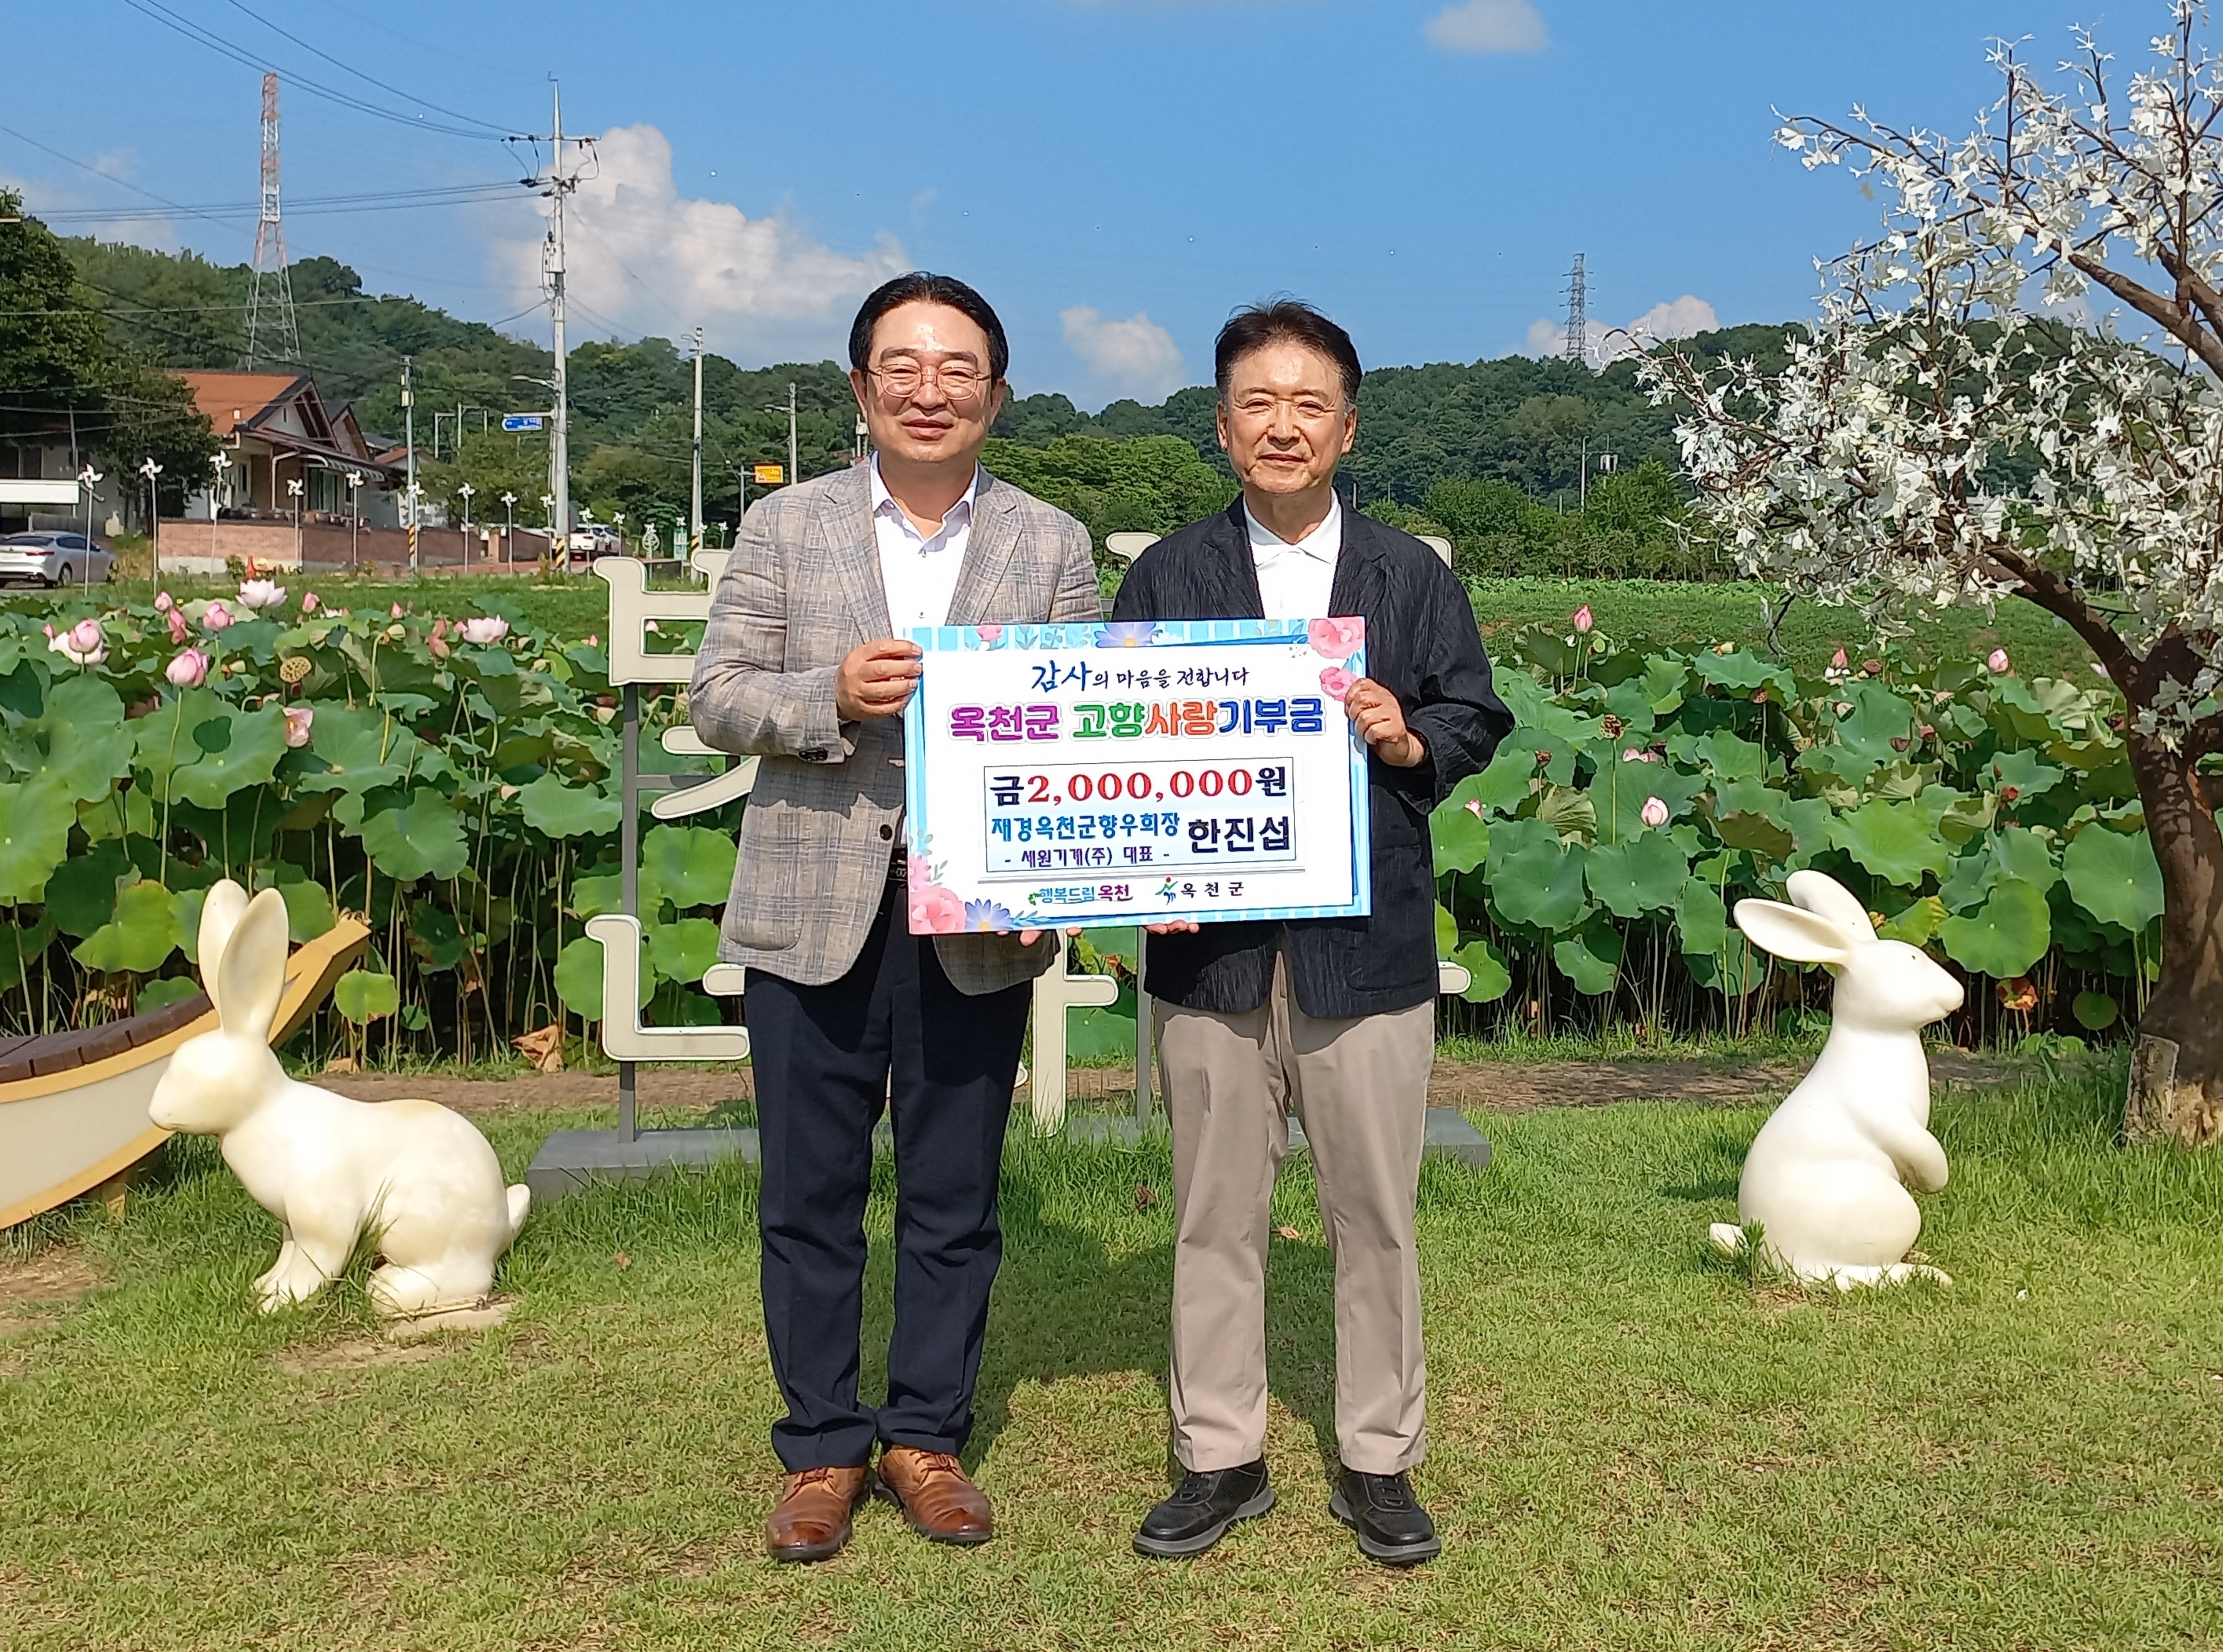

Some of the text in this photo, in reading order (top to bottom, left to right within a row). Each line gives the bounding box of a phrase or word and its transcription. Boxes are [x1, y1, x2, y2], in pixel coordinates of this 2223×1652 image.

[1031, 660, 1250, 693] 감사의 마음을 전합니다
[949, 697, 1325, 742] 옥천군 고향사랑기부금
[1187, 816, 1290, 854] 한진섭
[1123, 846, 1154, 864] 대표
